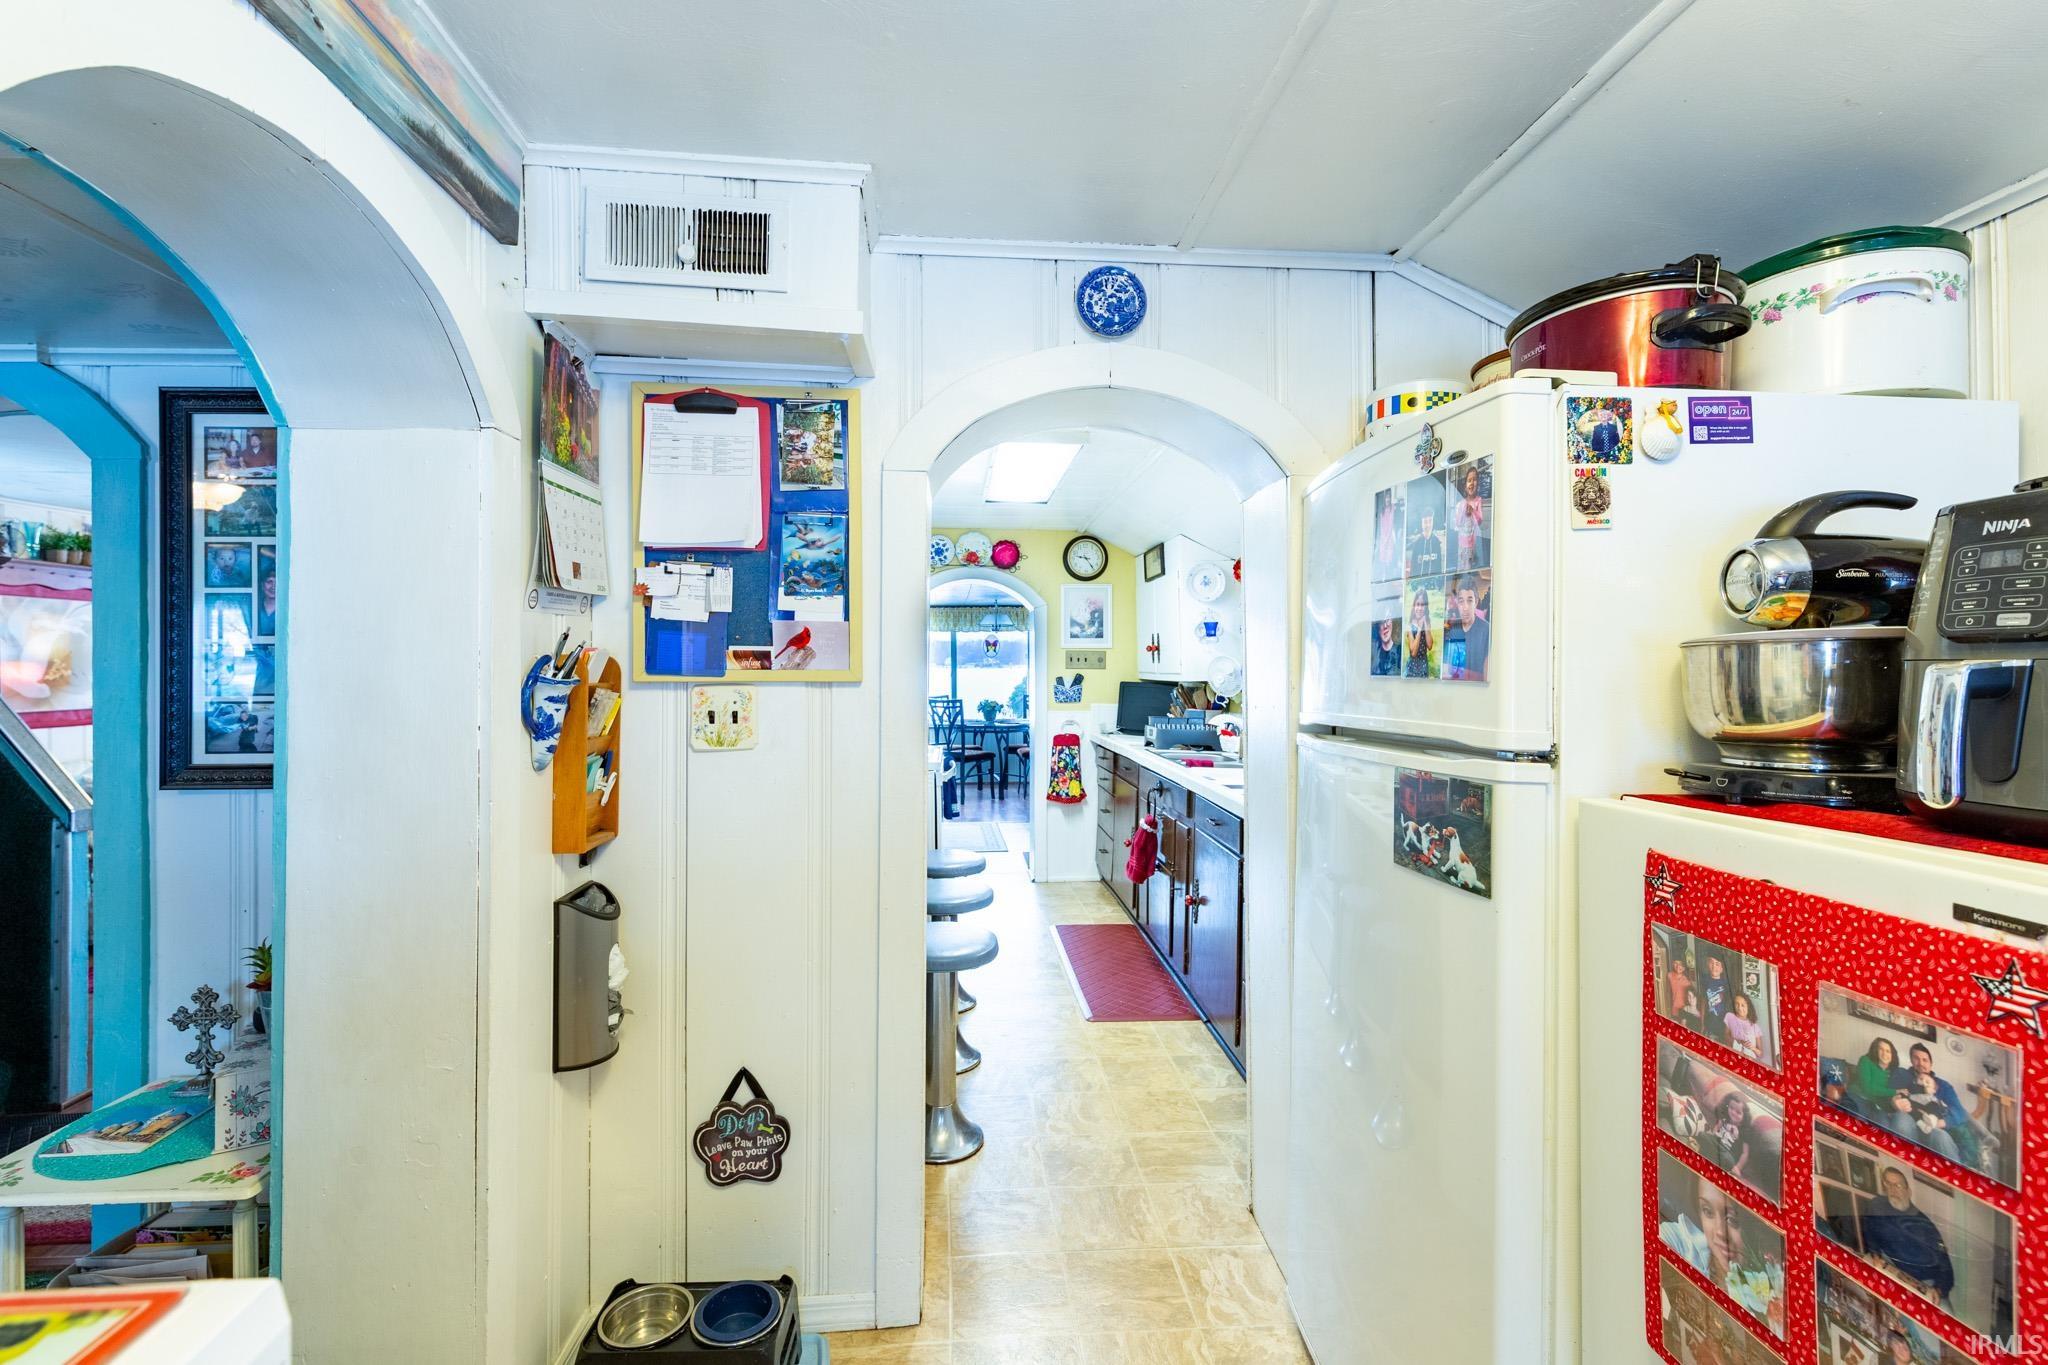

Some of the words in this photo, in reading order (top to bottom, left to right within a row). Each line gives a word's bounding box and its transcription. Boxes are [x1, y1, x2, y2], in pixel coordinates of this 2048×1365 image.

[1694, 405, 1727, 417] open
[1731, 408, 1747, 416] 24/7
[1982, 518, 2031, 536] NINJA
[1835, 568, 1870, 579] Sunbeam
[1973, 912, 2026, 932] Kenmore
[718, 1109, 765, 1139] Dogs
[704, 1142, 733, 1157] Leave
[734, 1136, 753, 1148] Paw
[757, 1134, 783, 1147] Prints
[732, 1149, 744, 1158] on
[746, 1147, 768, 1158] your
[720, 1157, 768, 1178] Heart
